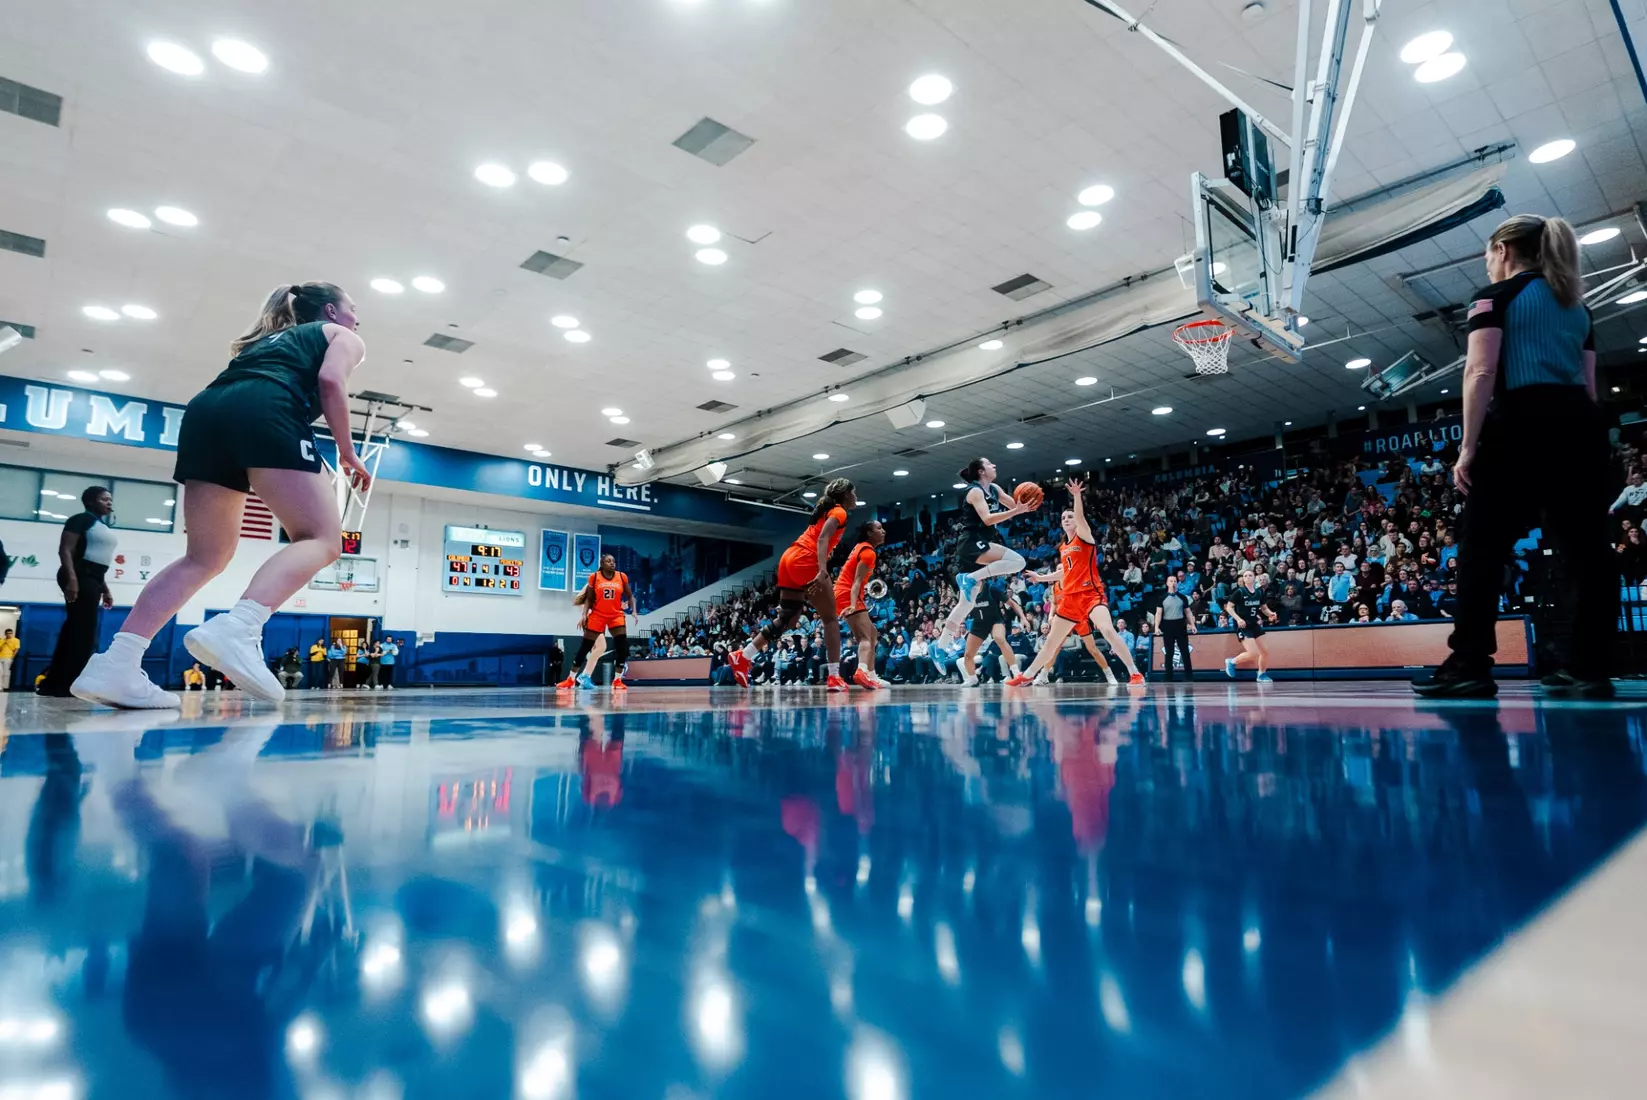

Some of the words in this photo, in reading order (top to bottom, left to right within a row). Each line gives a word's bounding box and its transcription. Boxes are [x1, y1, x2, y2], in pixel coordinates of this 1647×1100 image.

[300, 439, 315, 462] C
[528, 464, 586, 493] ONLY
[344, 540, 357, 553] 12
[976, 540, 986, 550] C
[477, 545, 501, 557] 9:17
[453, 562, 467, 572] 47
[1067, 555, 1073, 571] 1
[114, 569, 125, 579] P
[482, 565, 489, 573] 4
[506, 566, 520, 577] 43
[139, 570, 150, 581] Y
[452, 576, 458, 585] 0
[463, 577, 470, 586] 4
[483, 578, 495, 588] 12
[513, 581, 519, 589] 0
[603, 589, 615, 600] 21
[978, 609, 984, 620] 1
[1250, 607, 1257, 617] 5
